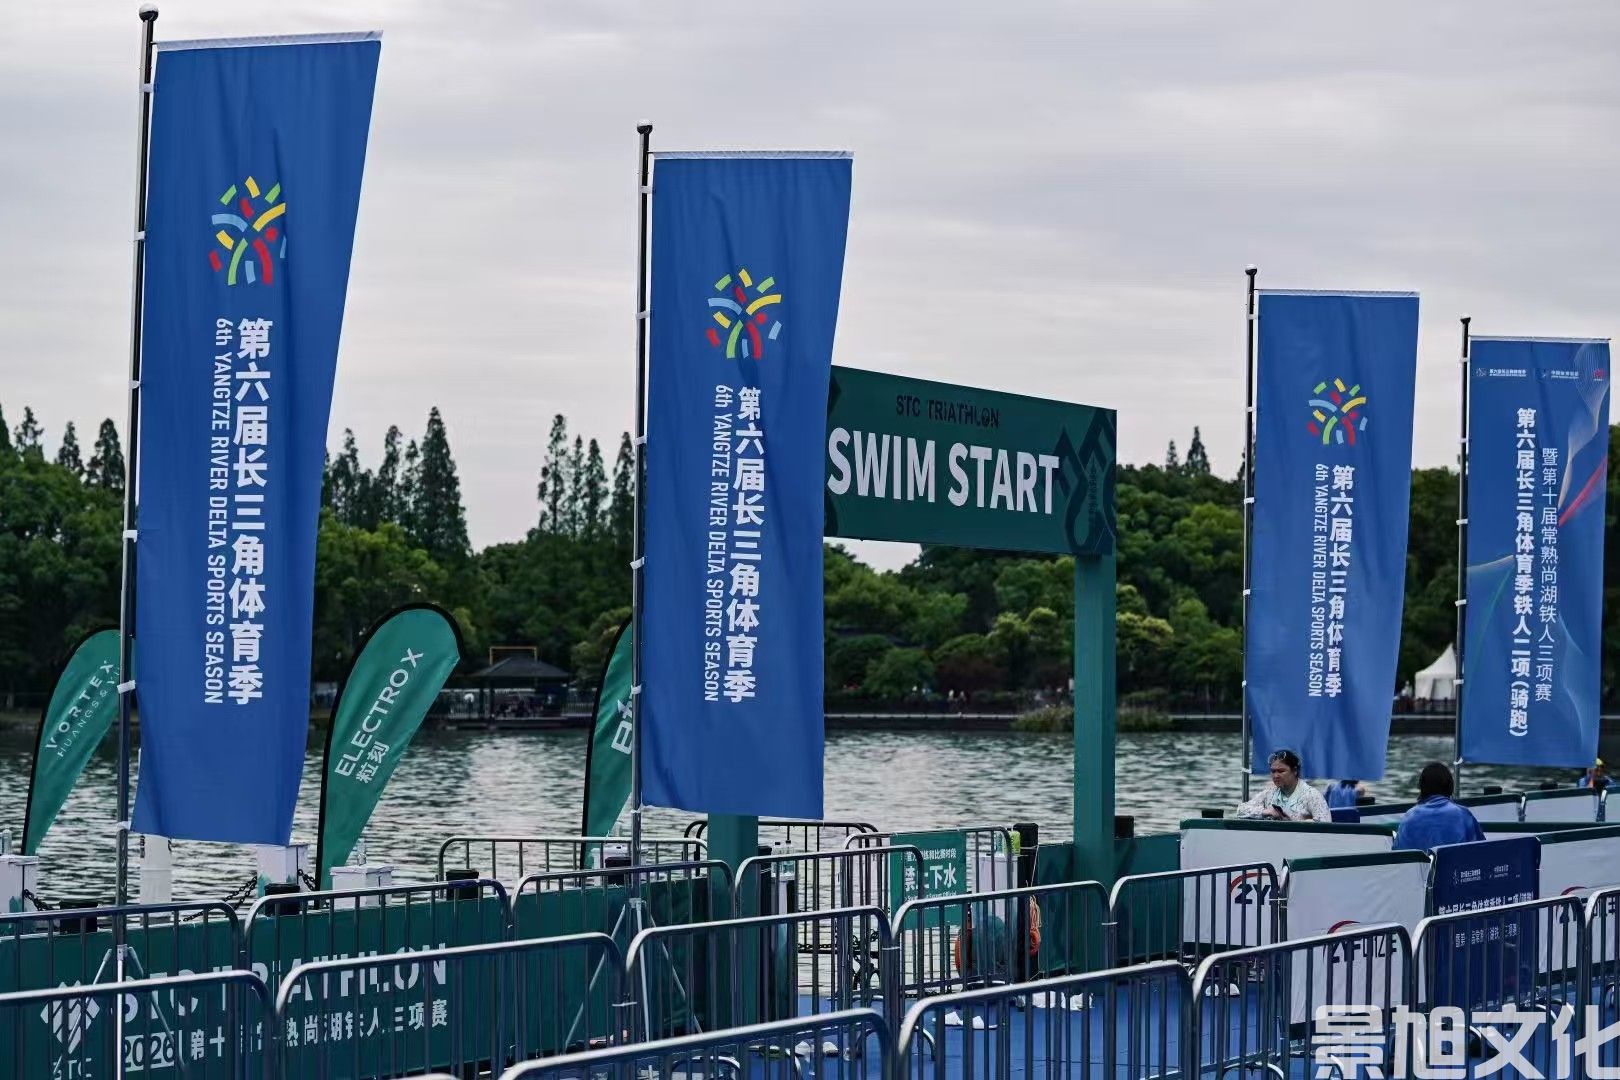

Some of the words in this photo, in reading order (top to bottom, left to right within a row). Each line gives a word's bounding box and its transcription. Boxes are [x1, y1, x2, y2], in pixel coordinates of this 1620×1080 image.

[216, 318, 233, 346] 6th
[212, 352, 232, 431] YANGTZE
[715, 384, 733, 408] 6th
[895, 394, 921, 418] STC
[210, 436, 230, 490] RIVER
[712, 413, 732, 477] YANGTZE
[827, 427, 936, 503] SWIM
[948, 442, 1059, 514] START
[1315, 464, 1329, 481] 6th
[208, 496, 228, 549] DELTA
[228, 318, 273, 705] 第六届长三角体育季
[709, 482, 728, 526] RIVER
[1314, 484, 1328, 532] YANGTZE
[707, 531, 726, 574] DELTA
[723, 386, 765, 703] 第六届长三角体育季
[1313, 535, 1327, 568] RIVER
[206, 555, 226, 625] SPORTS
[1312, 571, 1326, 603] DELTA
[1325, 464, 1355, 698] 第六届长三角体育季
[1535, 447, 1558, 702] 暨第十届常熟尚湖铁人三项赛
[705, 579, 724, 637] SPORTS
[1310, 606, 1325, 650] SPORTS
[205, 631, 224, 704] SEASON
[704, 642, 721, 702] SEASON
[1309, 653, 1323, 697] SEASON
[45, 660, 113, 749] VORTEX
